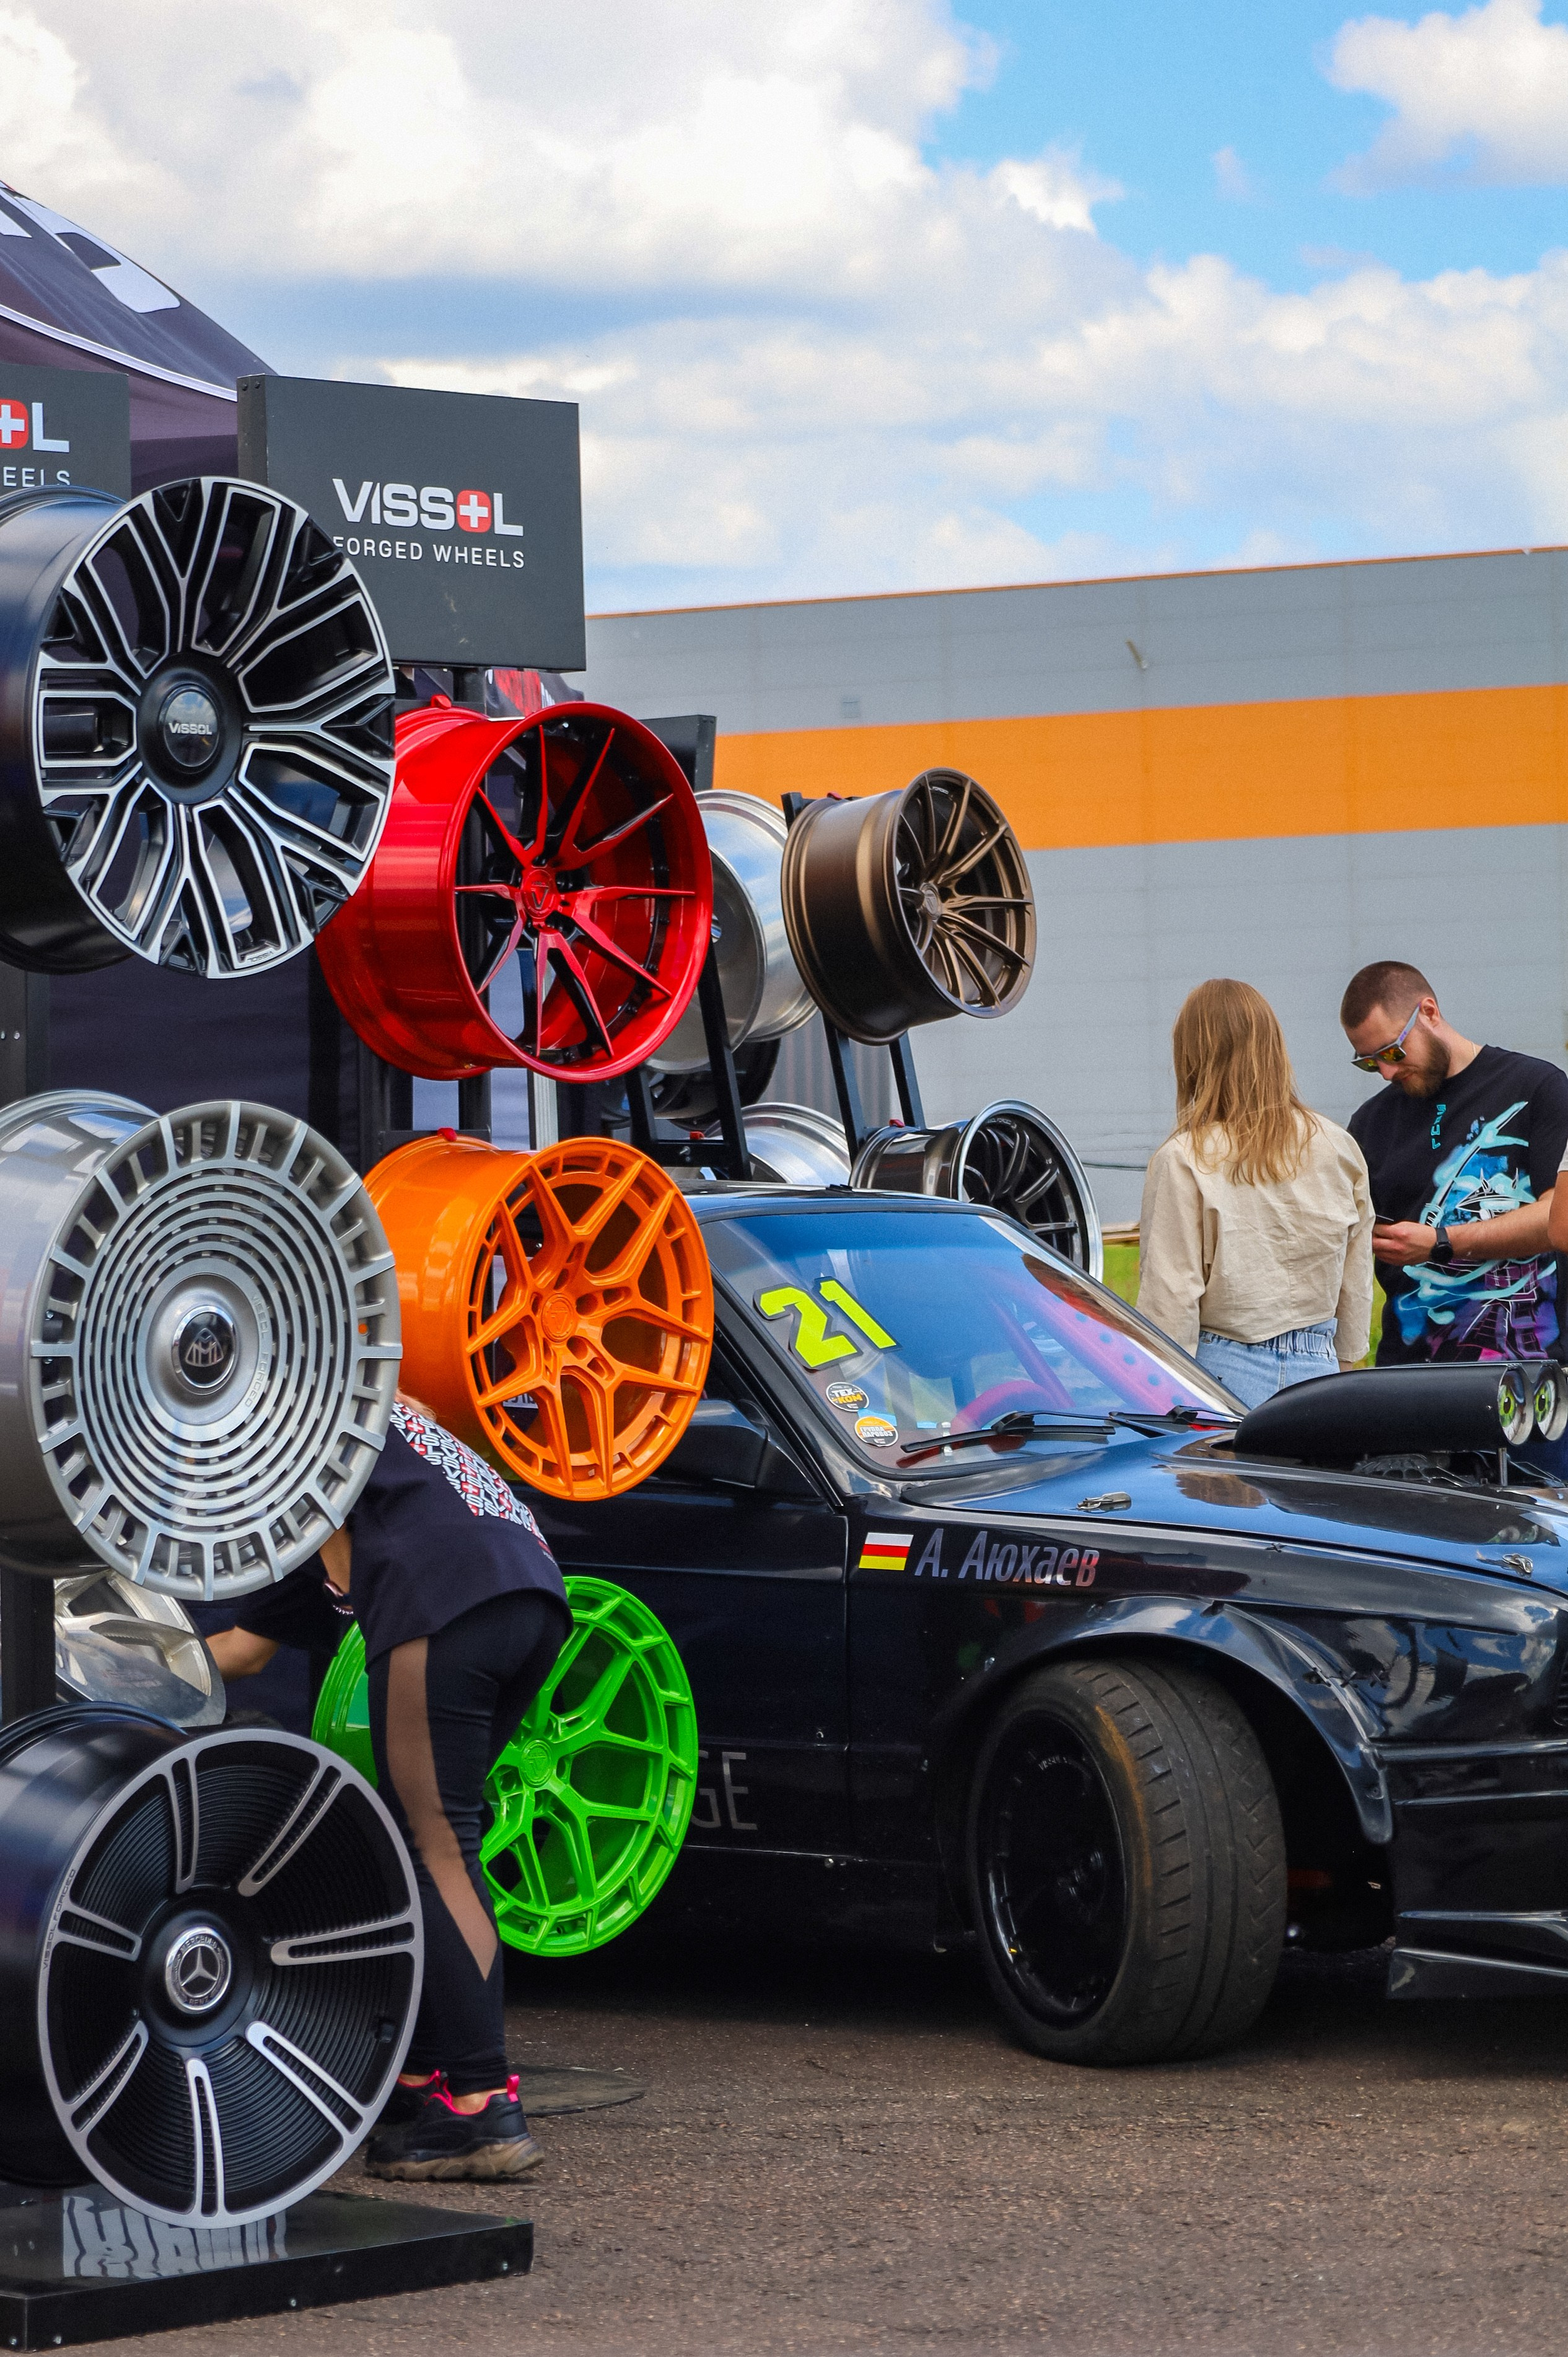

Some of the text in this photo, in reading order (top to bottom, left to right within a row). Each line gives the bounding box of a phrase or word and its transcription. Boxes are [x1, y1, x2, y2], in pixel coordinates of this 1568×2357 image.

[433, 544, 525, 569] WHEELS
[759, 1280, 897, 1367] 21
[914, 1528, 1100, 1587] А. Аюхаев
[43, 1869, 76, 1970] VISSOL FORGED
